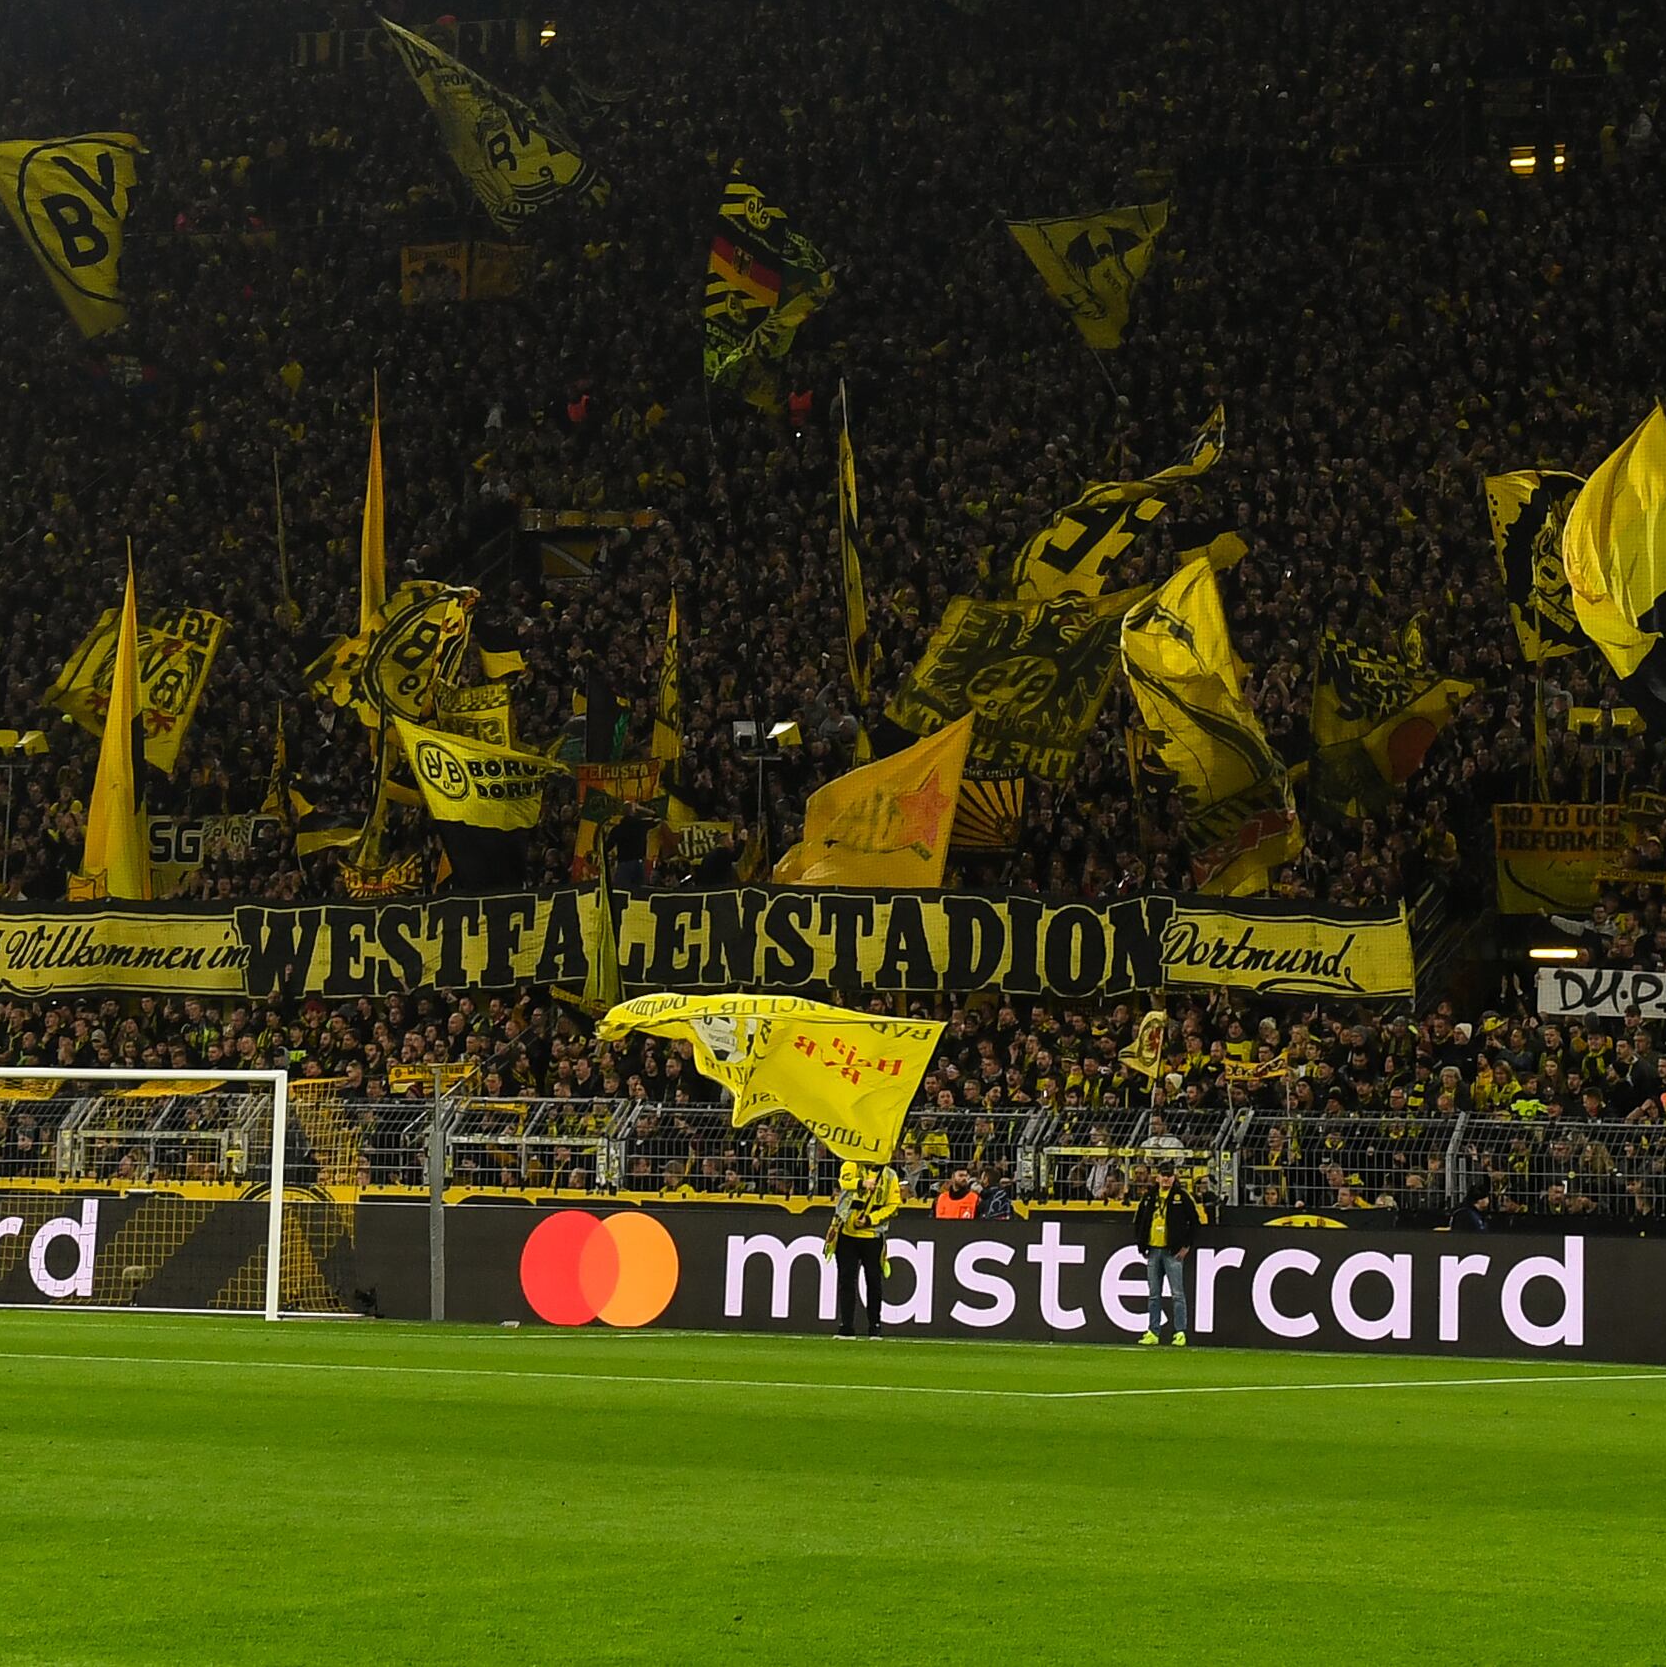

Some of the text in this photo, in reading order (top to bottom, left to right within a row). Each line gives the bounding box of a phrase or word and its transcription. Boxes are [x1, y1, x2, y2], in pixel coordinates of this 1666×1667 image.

[5, 924, 204, 970] Willkommen
[205, 931, 251, 971] im
[234, 889, 1176, 999] WESTFALENSTADION
[1160, 921, 1357, 979] Dortmund
